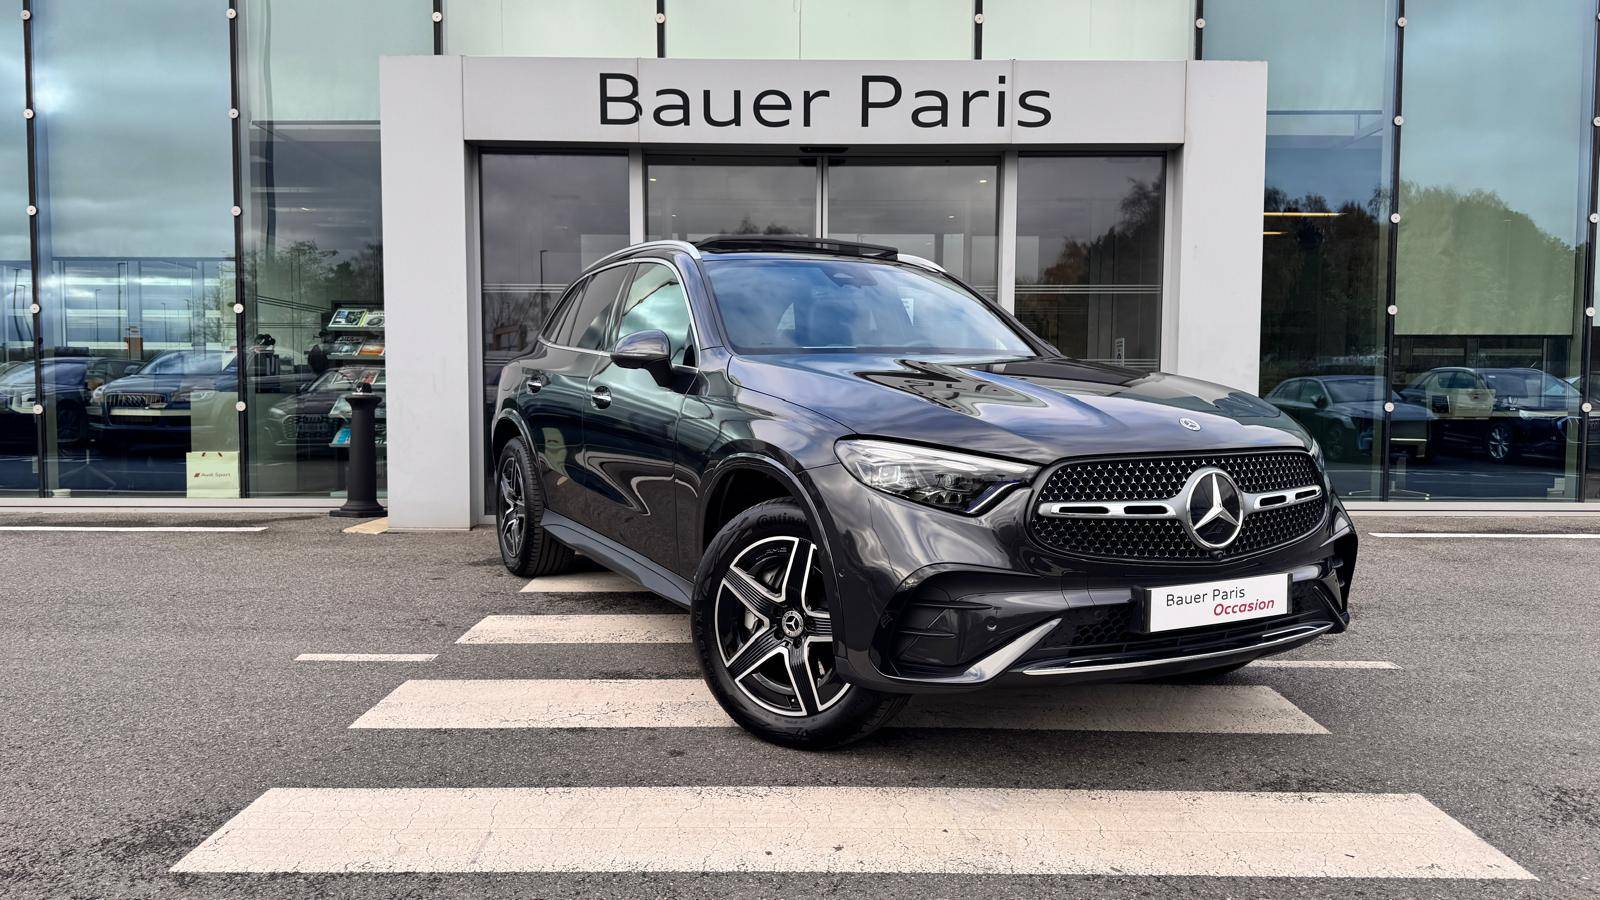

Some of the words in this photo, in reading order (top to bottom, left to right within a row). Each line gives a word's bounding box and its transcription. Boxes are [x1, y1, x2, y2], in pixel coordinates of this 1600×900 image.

[599, 73, 830, 127] Bauer
[861, 75, 1053, 128] Paris
[1166, 593, 1208, 607] Bauer
[1212, 586, 1246, 602] Paris
[1213, 598, 1275, 616] Occasion
